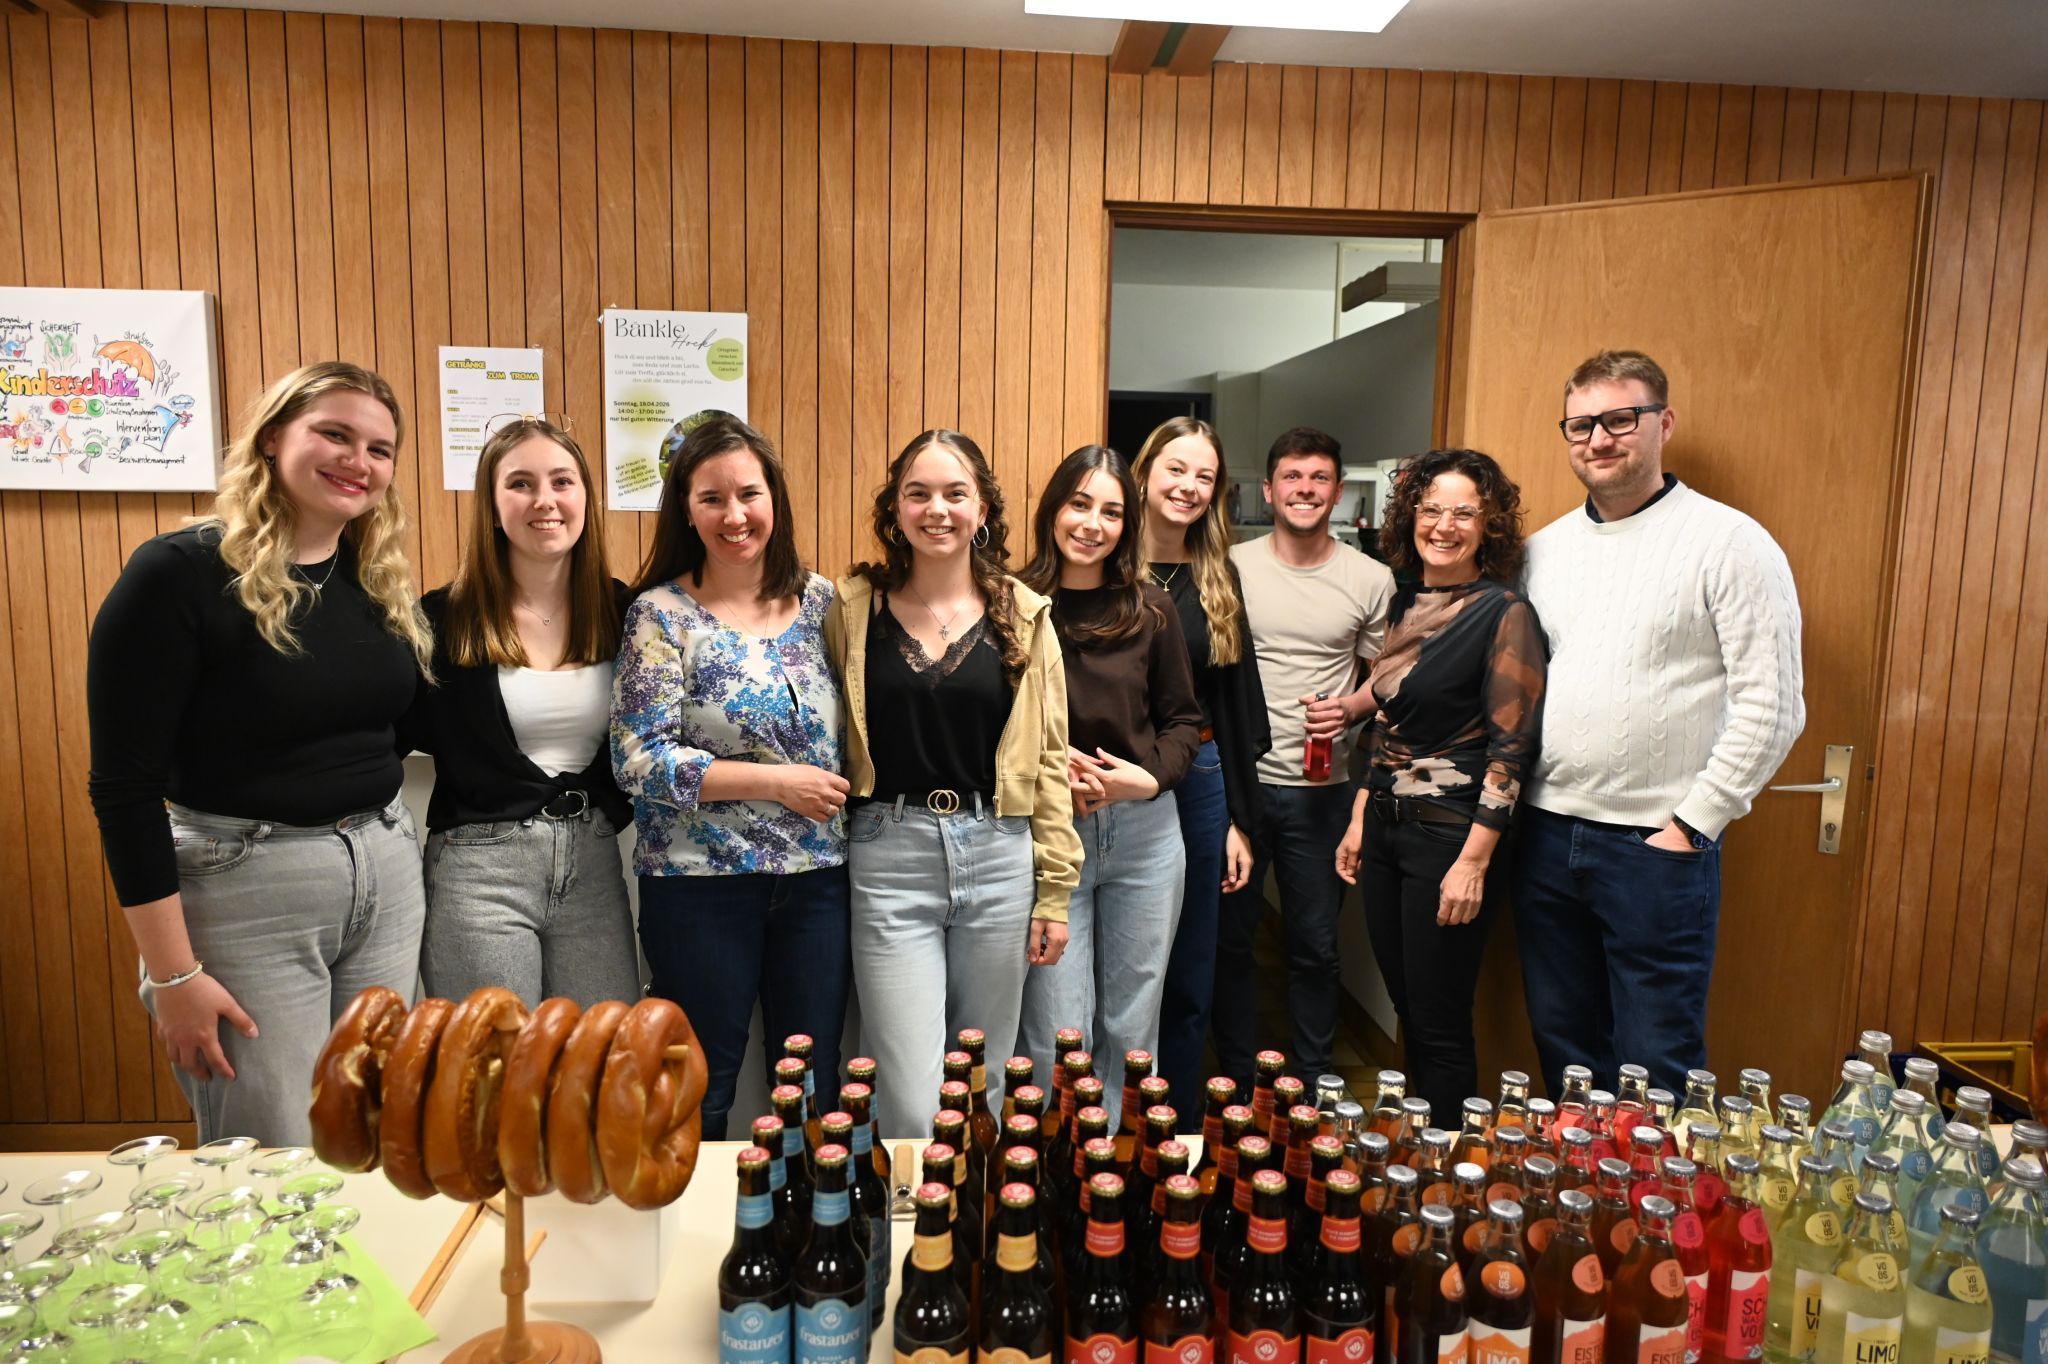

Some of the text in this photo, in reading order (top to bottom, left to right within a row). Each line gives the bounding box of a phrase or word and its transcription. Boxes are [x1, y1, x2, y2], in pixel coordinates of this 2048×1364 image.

[615, 318, 685, 338] Bänkle
[446, 358, 486, 369] GETRÄNKE
[487, 371, 506, 380] ZUM
[1822, 1219, 1832, 1228] VO
[1876, 1262, 1887, 1270] VO
[1966, 1275, 1977, 1283] VO
[722, 1330, 785, 1350] frastanzer
[800, 1326, 860, 1347] frastanzer
[1856, 1342, 1897, 1363] LIMO
